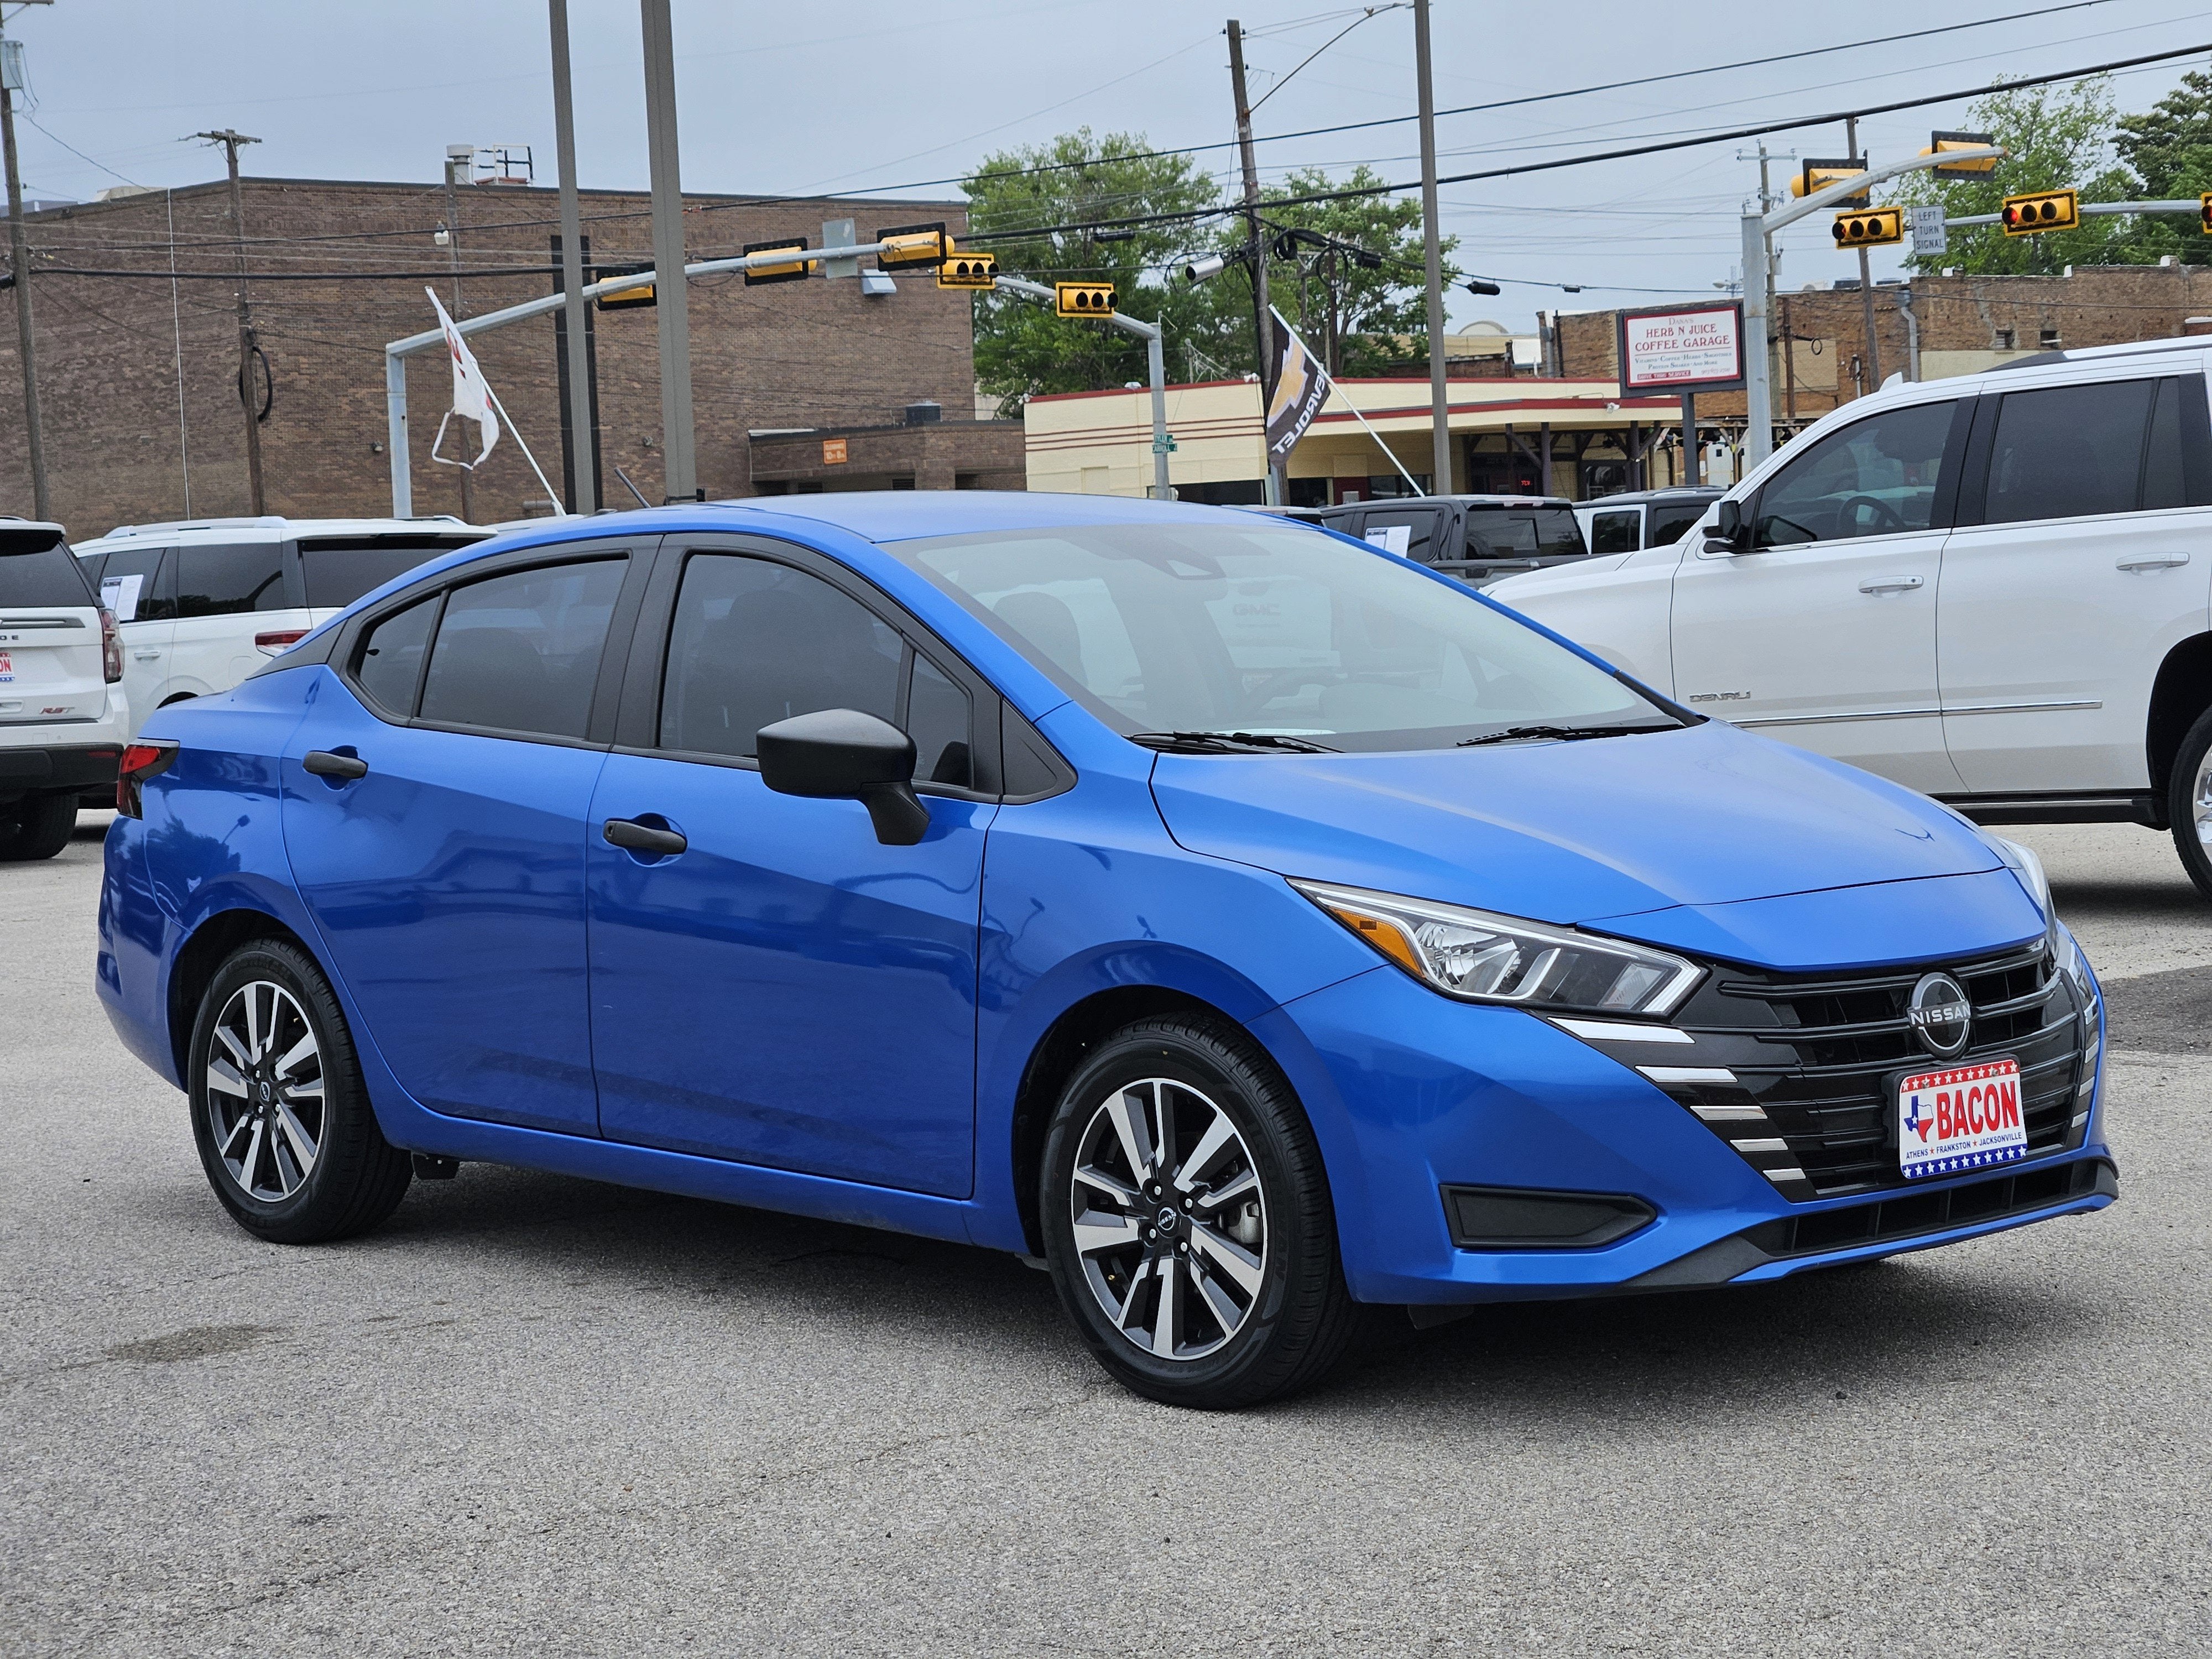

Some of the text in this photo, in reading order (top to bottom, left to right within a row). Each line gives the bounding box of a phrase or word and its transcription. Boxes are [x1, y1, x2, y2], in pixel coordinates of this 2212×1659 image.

[1918, 211, 1936, 221] LEFT
[1919, 225, 1939, 235] TURN
[1917, 239, 1944, 249] SIGNAL
[1646, 324, 1717, 338] HERB N JUICE
[1635, 335, 1730, 351] COFFEE GARAGE
[1233, 603, 1281, 616] GMC
[1689, 691, 1751, 702] DENALI
[1910, 1005, 1971, 1026] NISSAN
[1936, 1080, 2020, 1141] BACON
[1906, 1132, 2022, 1160] ATHENS FRANKSTON JACKSONVILLE
